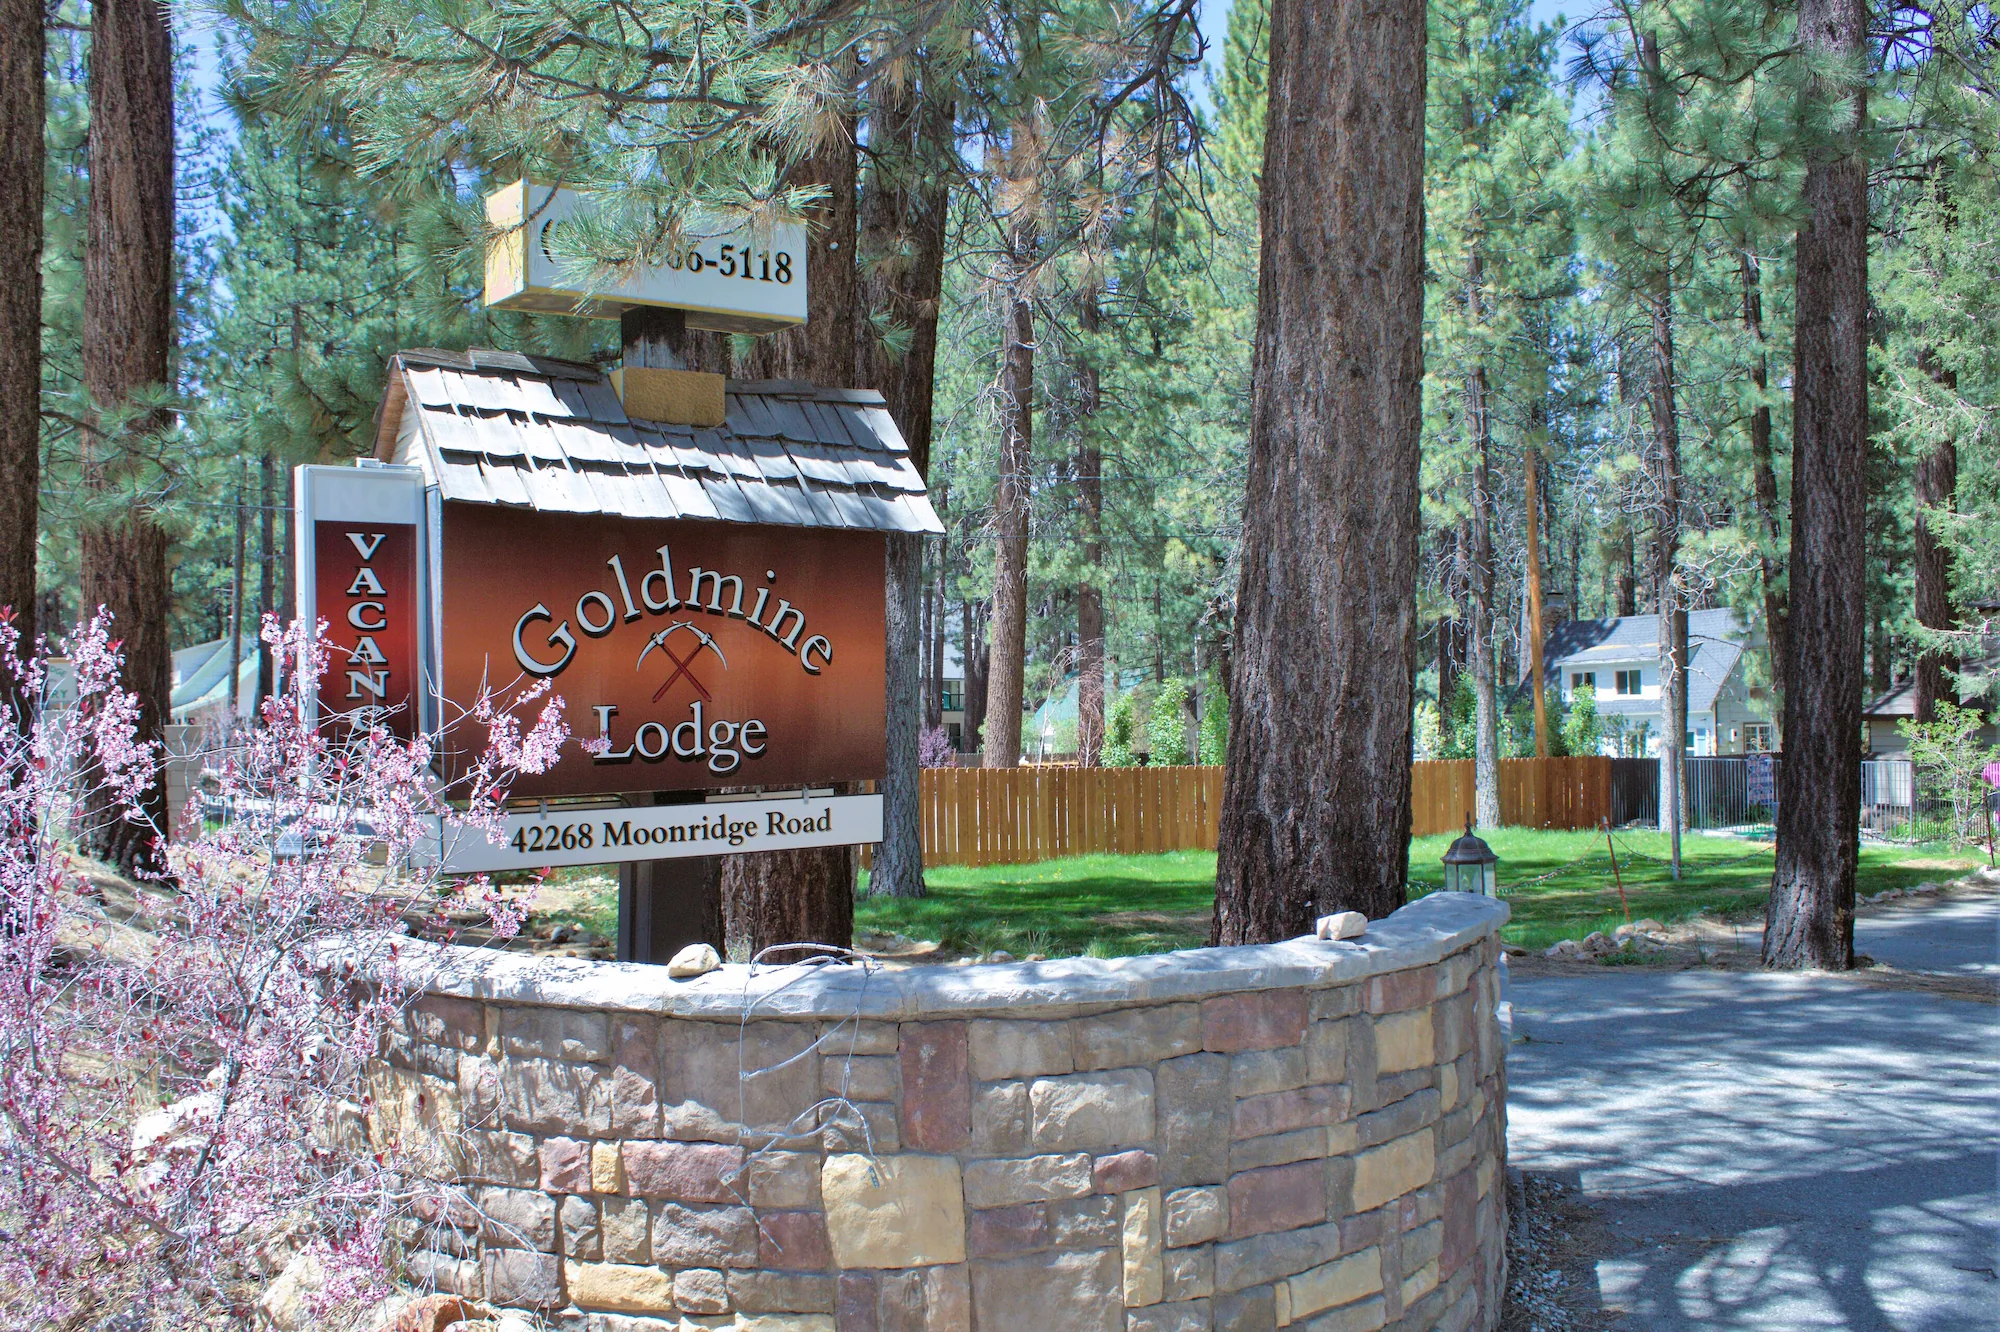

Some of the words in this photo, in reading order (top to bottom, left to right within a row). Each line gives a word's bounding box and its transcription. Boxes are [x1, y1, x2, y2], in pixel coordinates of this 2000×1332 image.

[511, 544, 833, 677] Goldmine
[592, 700, 768, 774] Lodge
[511, 822, 595, 854] 42268
[602, 815, 758, 850] Moonridge
[765, 808, 832, 837] Road
